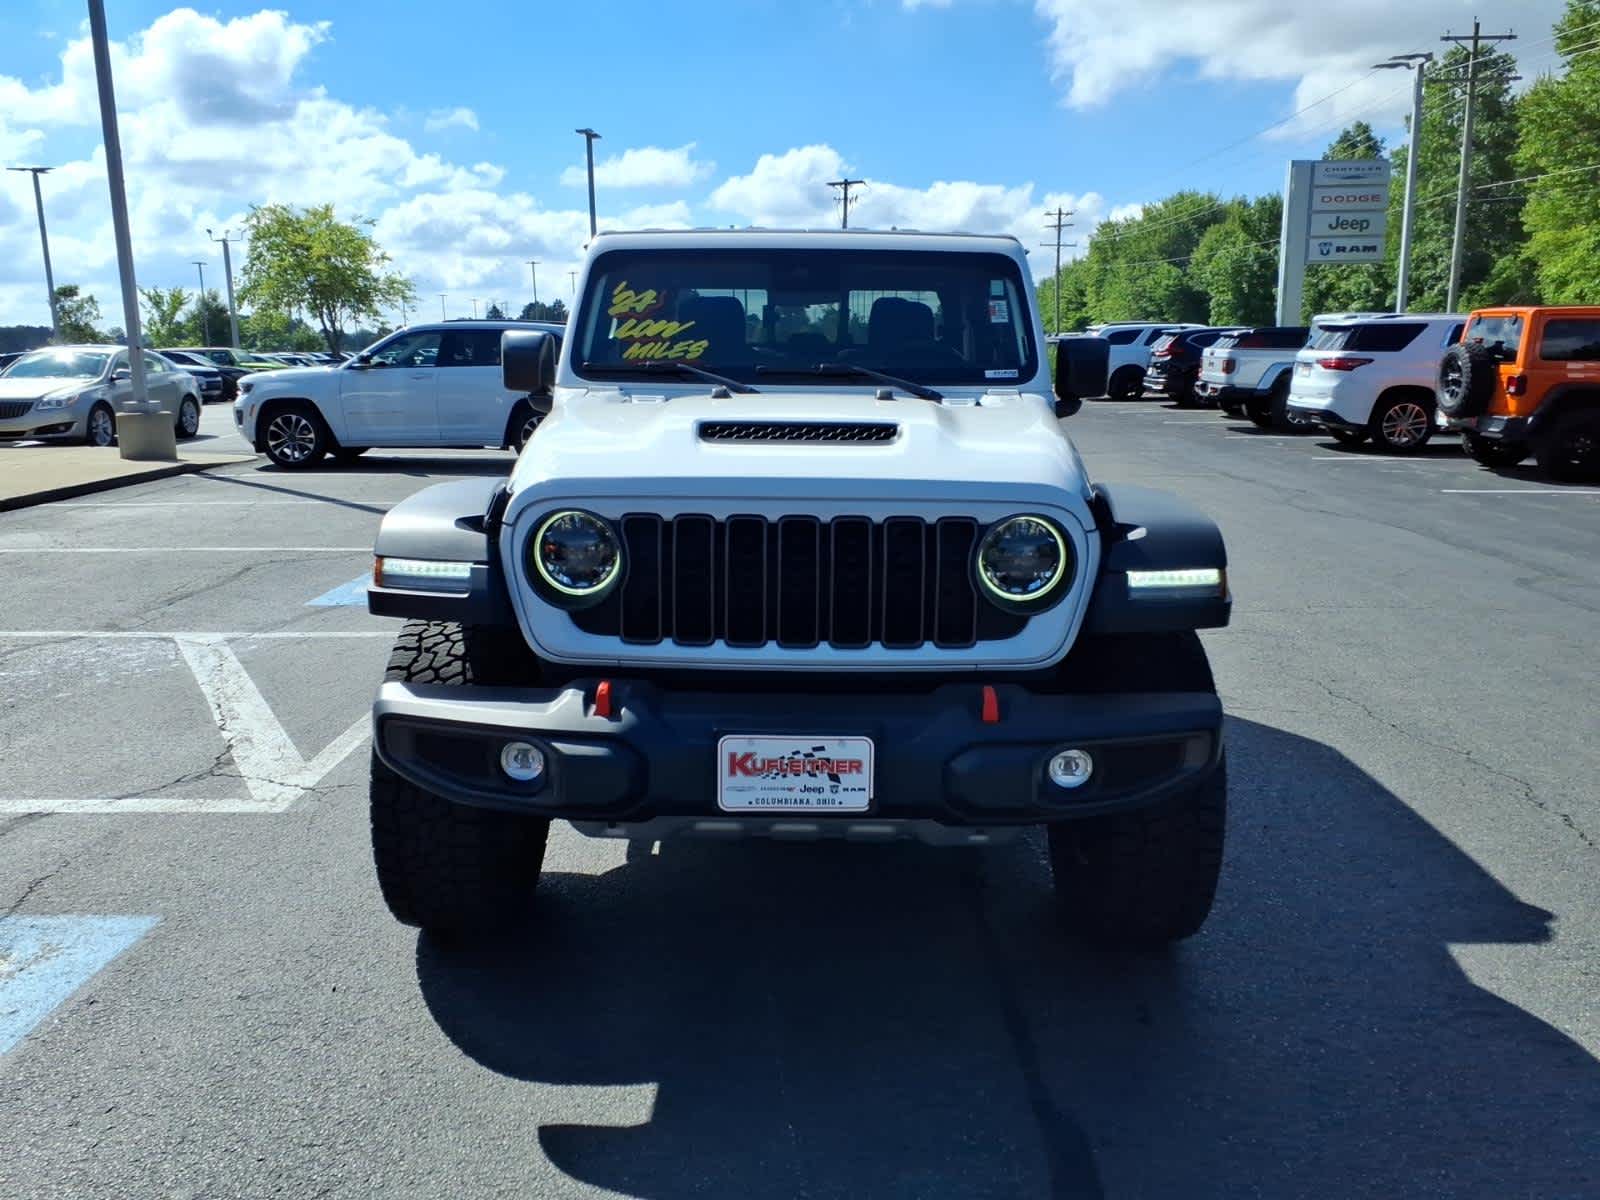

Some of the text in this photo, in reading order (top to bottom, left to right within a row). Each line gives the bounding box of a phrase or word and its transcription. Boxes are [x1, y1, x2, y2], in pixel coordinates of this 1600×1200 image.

[1321, 194, 1382, 203] DODGE
[1328, 216, 1370, 232] Jeep
[1335, 245, 1377, 253] RAM
[622, 340, 709, 360] MILES
[728, 751, 864, 777] KUFLEITNER
[799, 784, 825, 794] Jeep
[755, 798, 837, 806] COLUMBIANA, OHIO
